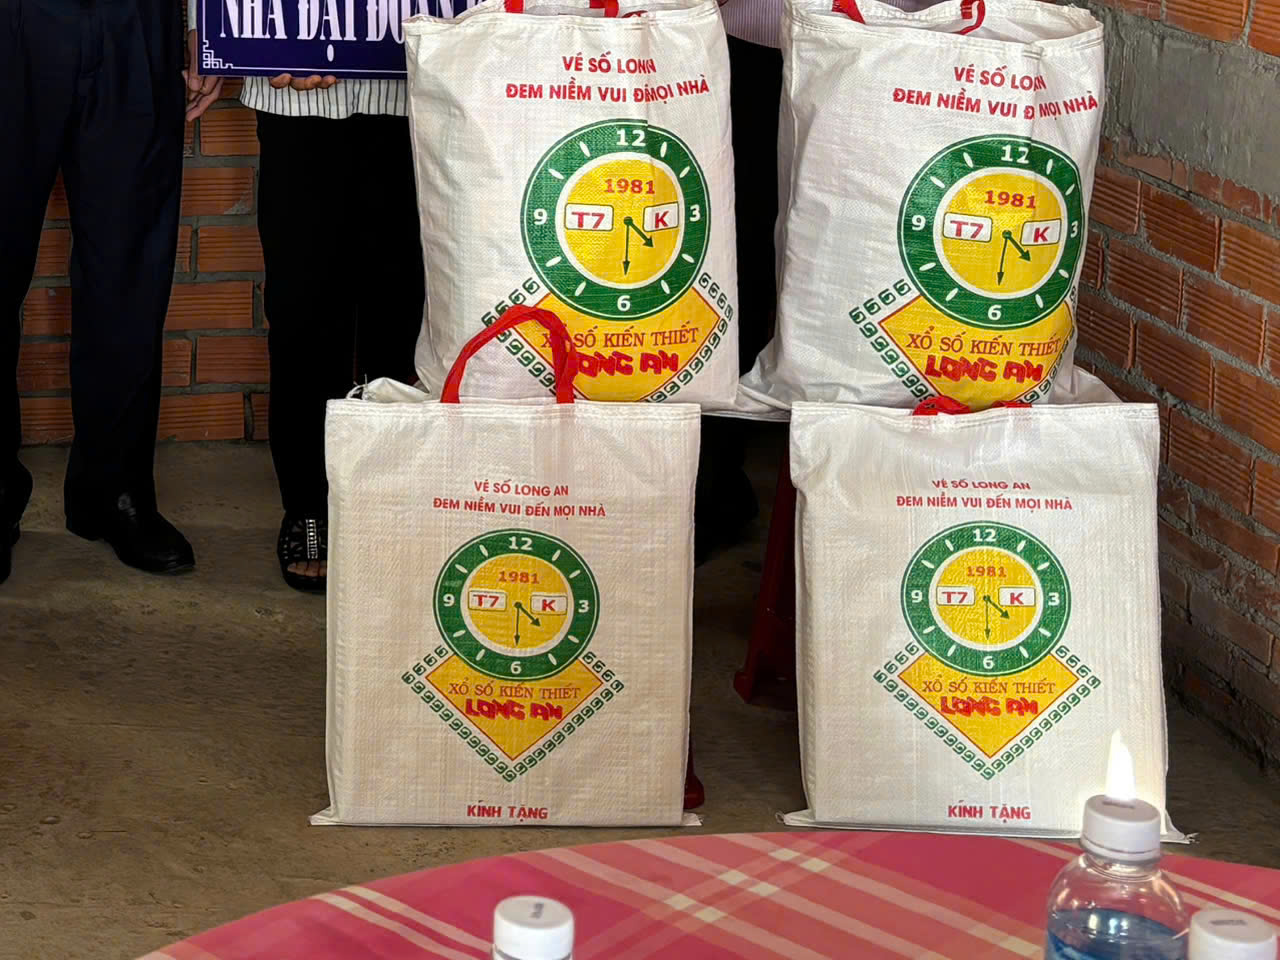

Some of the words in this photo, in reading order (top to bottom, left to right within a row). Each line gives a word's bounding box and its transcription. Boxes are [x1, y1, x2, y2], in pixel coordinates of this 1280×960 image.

[562, 52, 583, 71] VÉ
[588, 51, 611, 73] SỐ
[954, 64, 975, 83] VÉ
[980, 65, 1008, 87] SỐ
[506, 84, 542, 99] ĐEM
[550, 77, 591, 101] NIỀM
[598, 87, 626, 102] VUI
[678, 74, 709, 96] NHÀ
[893, 88, 931, 106] ĐEM
[937, 88, 980, 112] NIỀM
[988, 100, 1017, 118] VUI
[1039, 101, 1061, 120] MỌI
[1065, 90, 1098, 113] NHÀ
[616, 130, 646, 146] 12
[604, 178, 655, 194] 1981
[984, 191, 1036, 208] 1981
[572, 212, 605, 229] T7
[655, 211, 670, 228] K
[950, 220, 984, 239] T7
[1033, 226, 1050, 242] K
[574, 326, 598, 348] SỐ
[604, 326, 646, 347] KIẾN
[651, 321, 699, 346] THIẾT
[433, 498, 459, 509] ĐEM
[500, 504, 520, 515] VUI
[526, 502, 550, 516] ĐẾN
[554, 506, 574, 520] MỌI
[579, 504, 605, 516] NHÀ
[897, 496, 922, 506] ĐEM
[962, 497, 981, 508] VUI
[986, 494, 1011, 508] ĐẾN
[1016, 498, 1040, 512] MỌI
[467, 800, 501, 817] KÍNH
[948, 800, 983, 818] KÍNH
